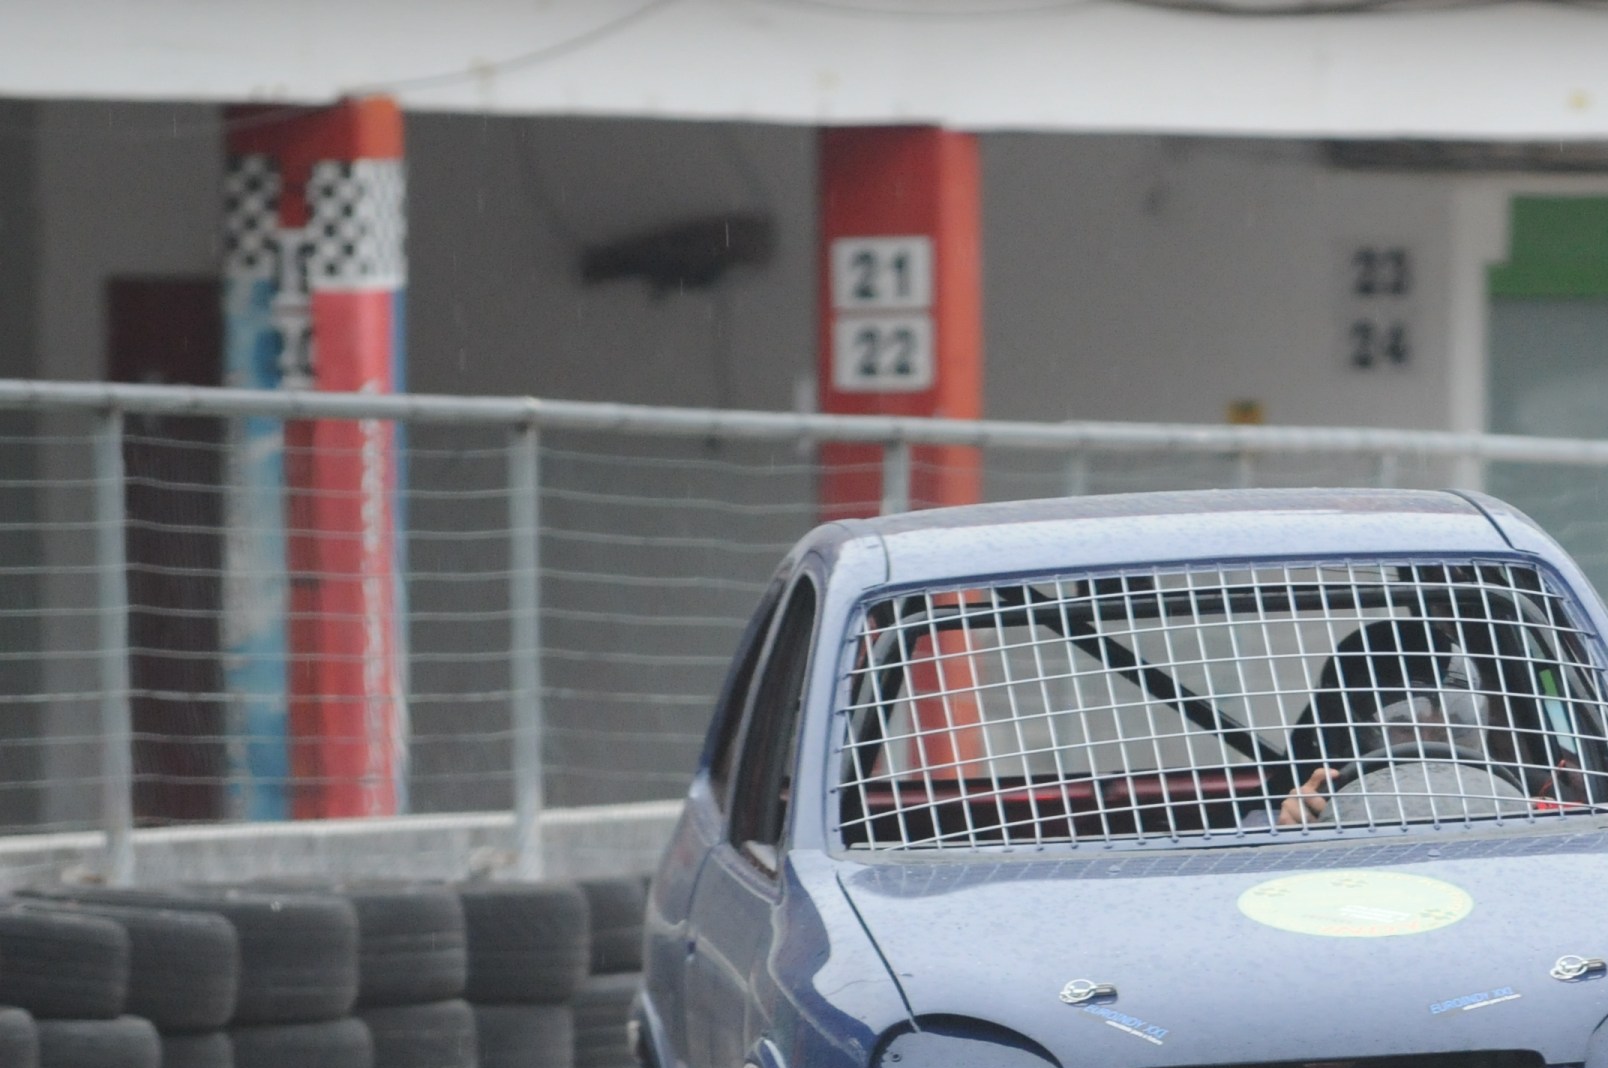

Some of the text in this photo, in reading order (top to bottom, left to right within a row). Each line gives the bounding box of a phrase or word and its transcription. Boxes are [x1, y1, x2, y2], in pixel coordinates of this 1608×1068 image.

[851, 249, 910, 299] 21
[854, 325, 917, 377] 22
[1352, 318, 1411, 370] 24
[1083, 1003, 1146, 1028] EUROINDY
[1429, 992, 1489, 1014] EUROINDY
